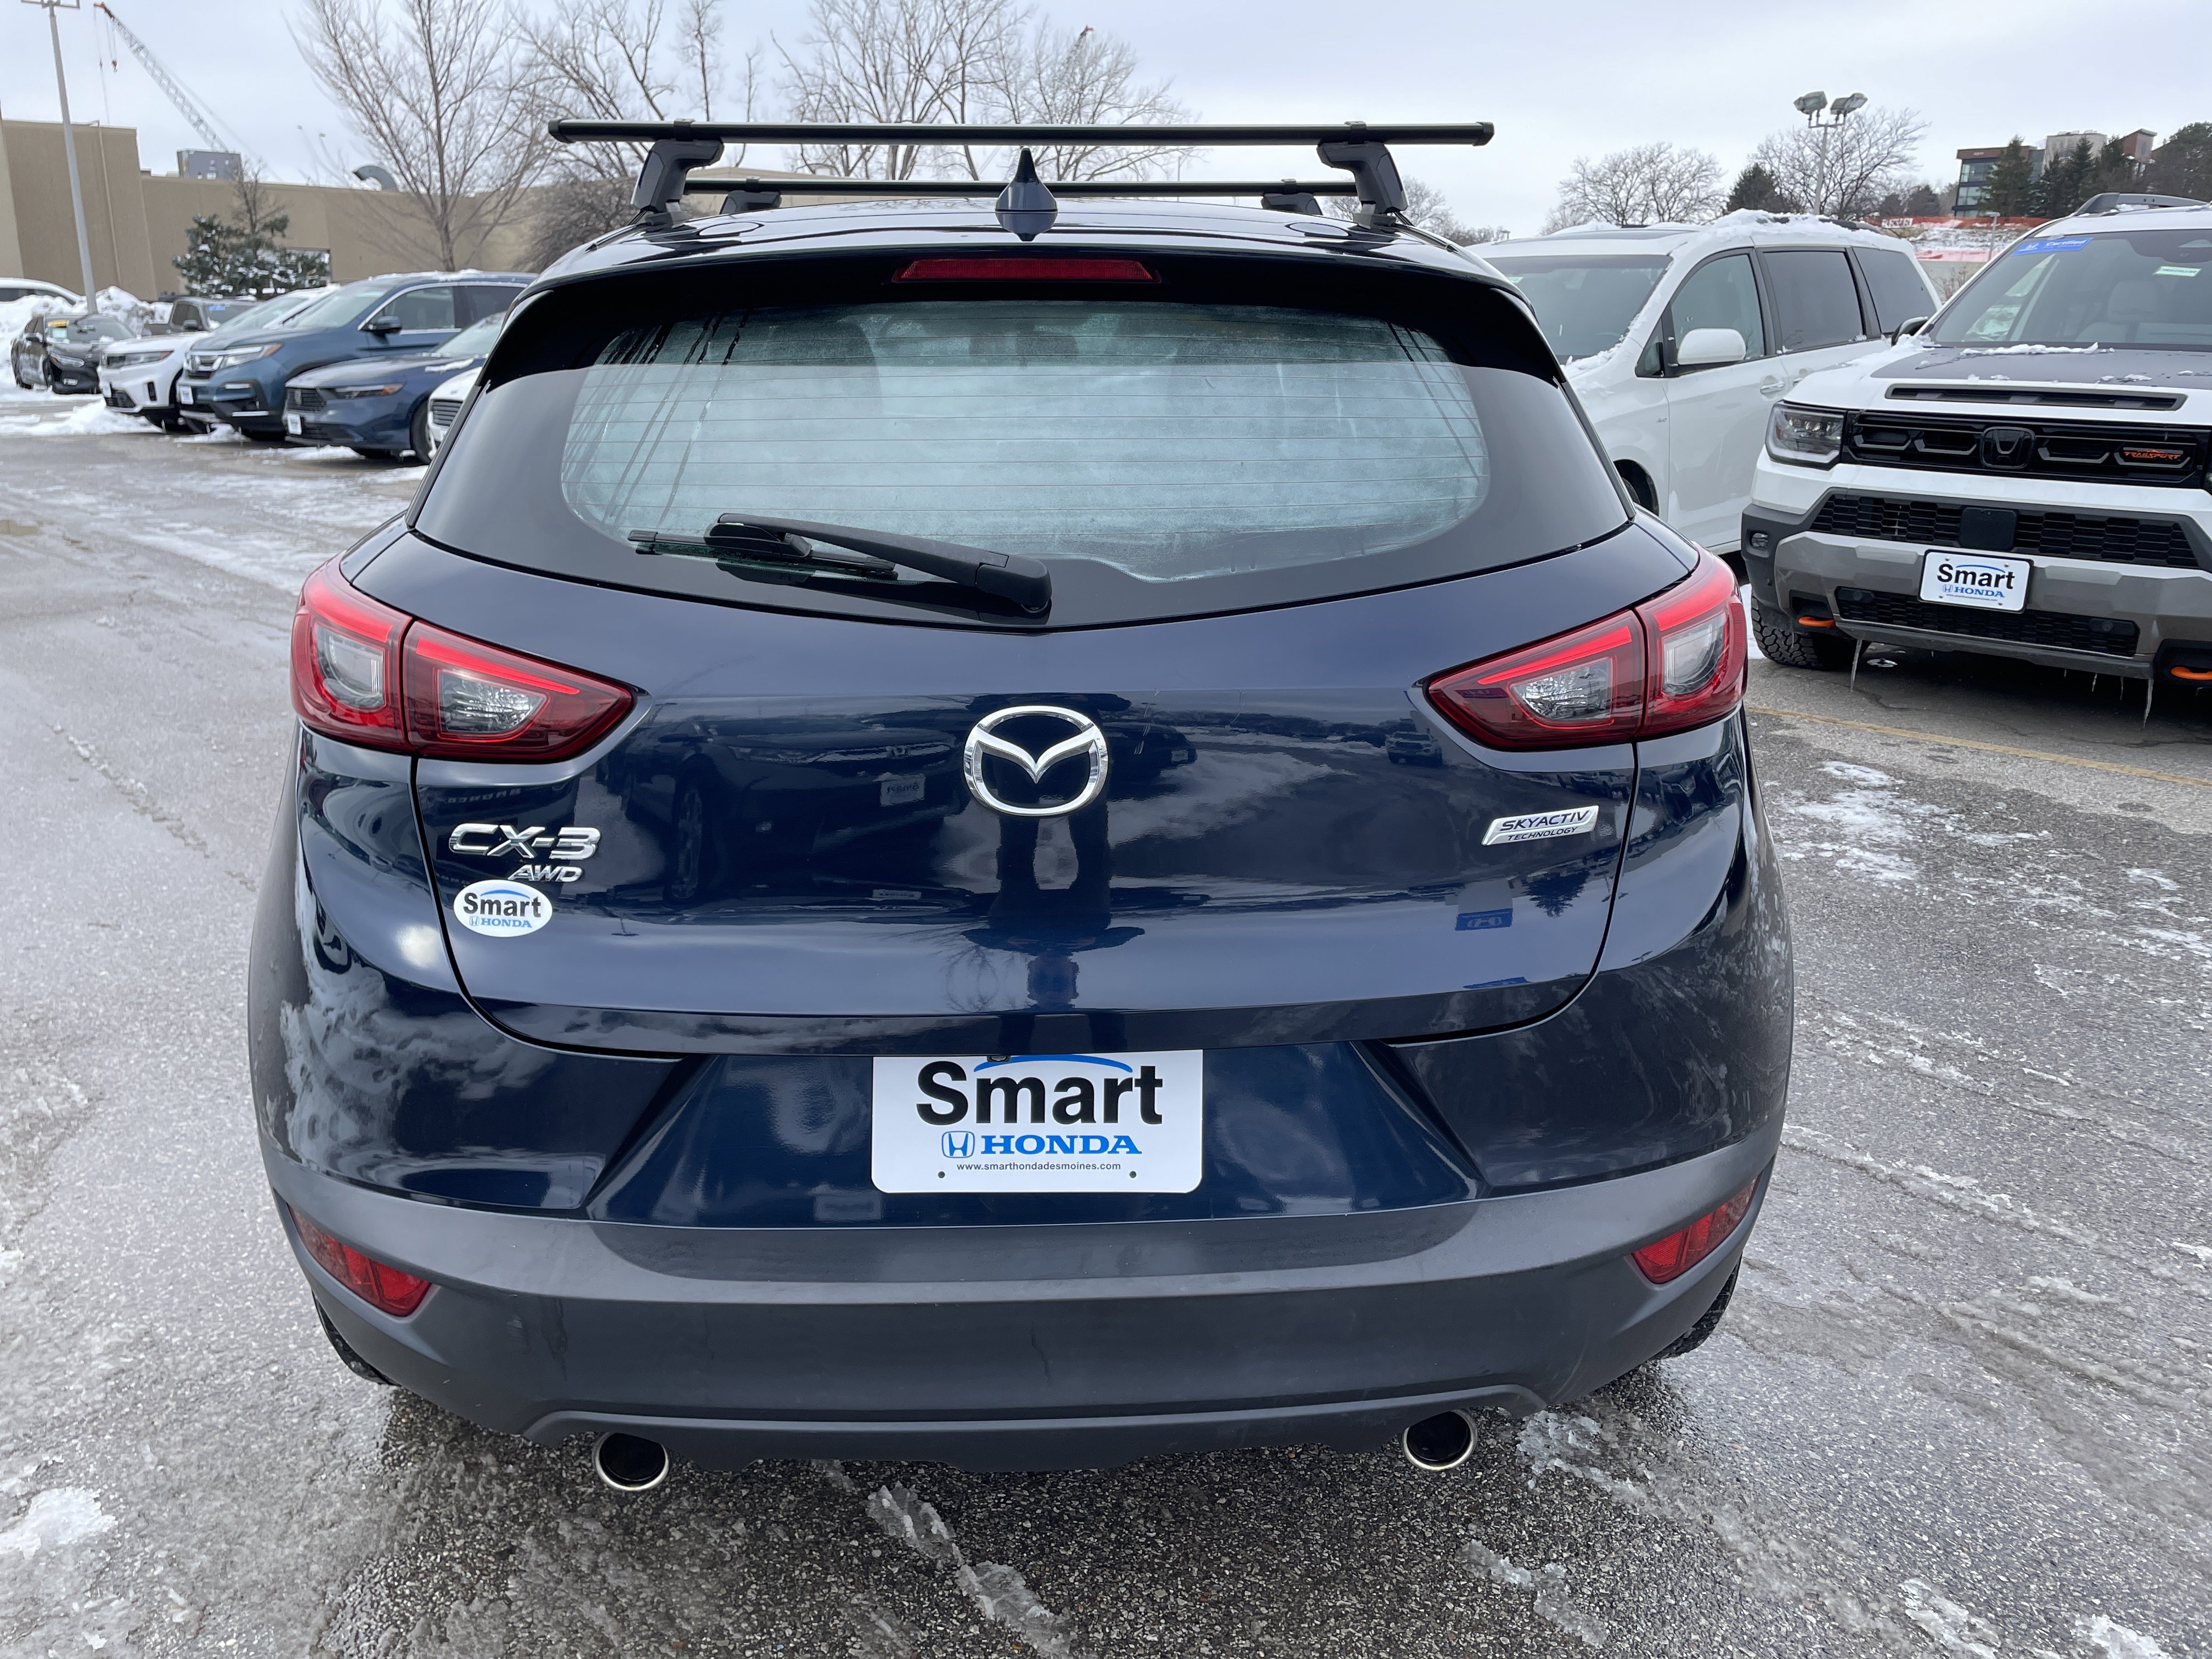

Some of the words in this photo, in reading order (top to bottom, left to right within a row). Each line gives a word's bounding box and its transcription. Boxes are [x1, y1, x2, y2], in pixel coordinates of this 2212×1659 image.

[1937, 563, 2015, 590] Smart
[1954, 586, 2005, 597] HONDA
[1500, 810, 1590, 831] SKYACTIV
[449, 823, 600, 860] CX-3
[1508, 827, 1578, 841] TECHNOLOGY
[507, 865, 583, 882] AWD
[463, 893, 541, 917] Smart
[481, 918, 532, 928] HONDA
[916, 1060, 1163, 1125] Smart
[981, 1135, 1142, 1154] HONDA
[956, 1161, 1121, 1171] www.smarthondadesmoines.com
